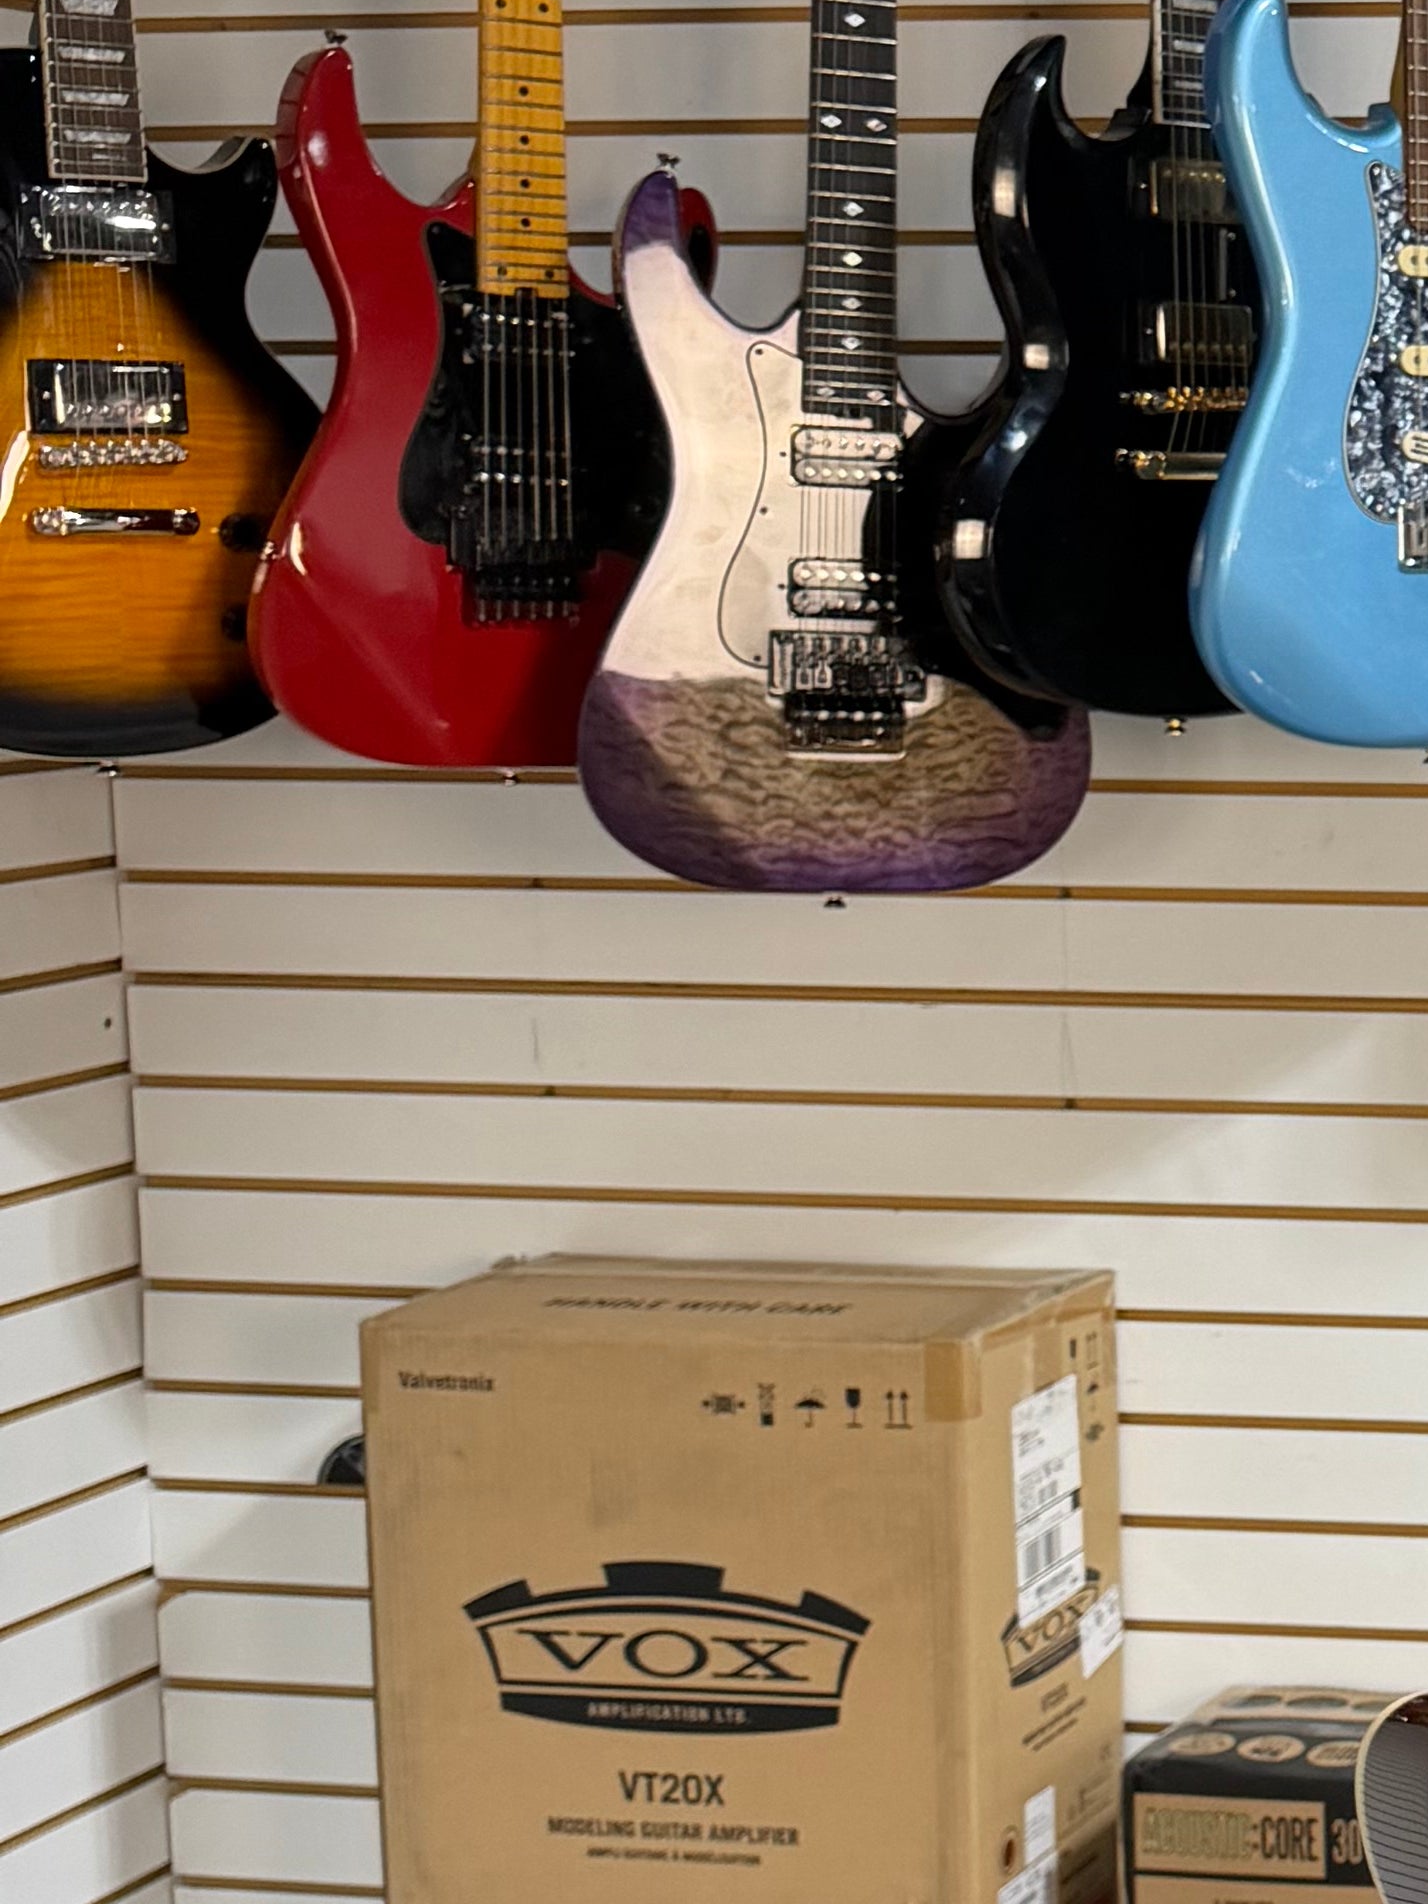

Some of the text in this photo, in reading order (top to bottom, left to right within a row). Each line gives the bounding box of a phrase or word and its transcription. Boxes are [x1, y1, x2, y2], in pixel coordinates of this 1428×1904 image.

[516, 1627, 811, 1682] VOX
[586, 1702, 710, 1723] AMPLIFICATION
[617, 1770, 725, 1807] VT20X
[547, 1815, 799, 1847] MODELING GUITAR AMPLIFIER
